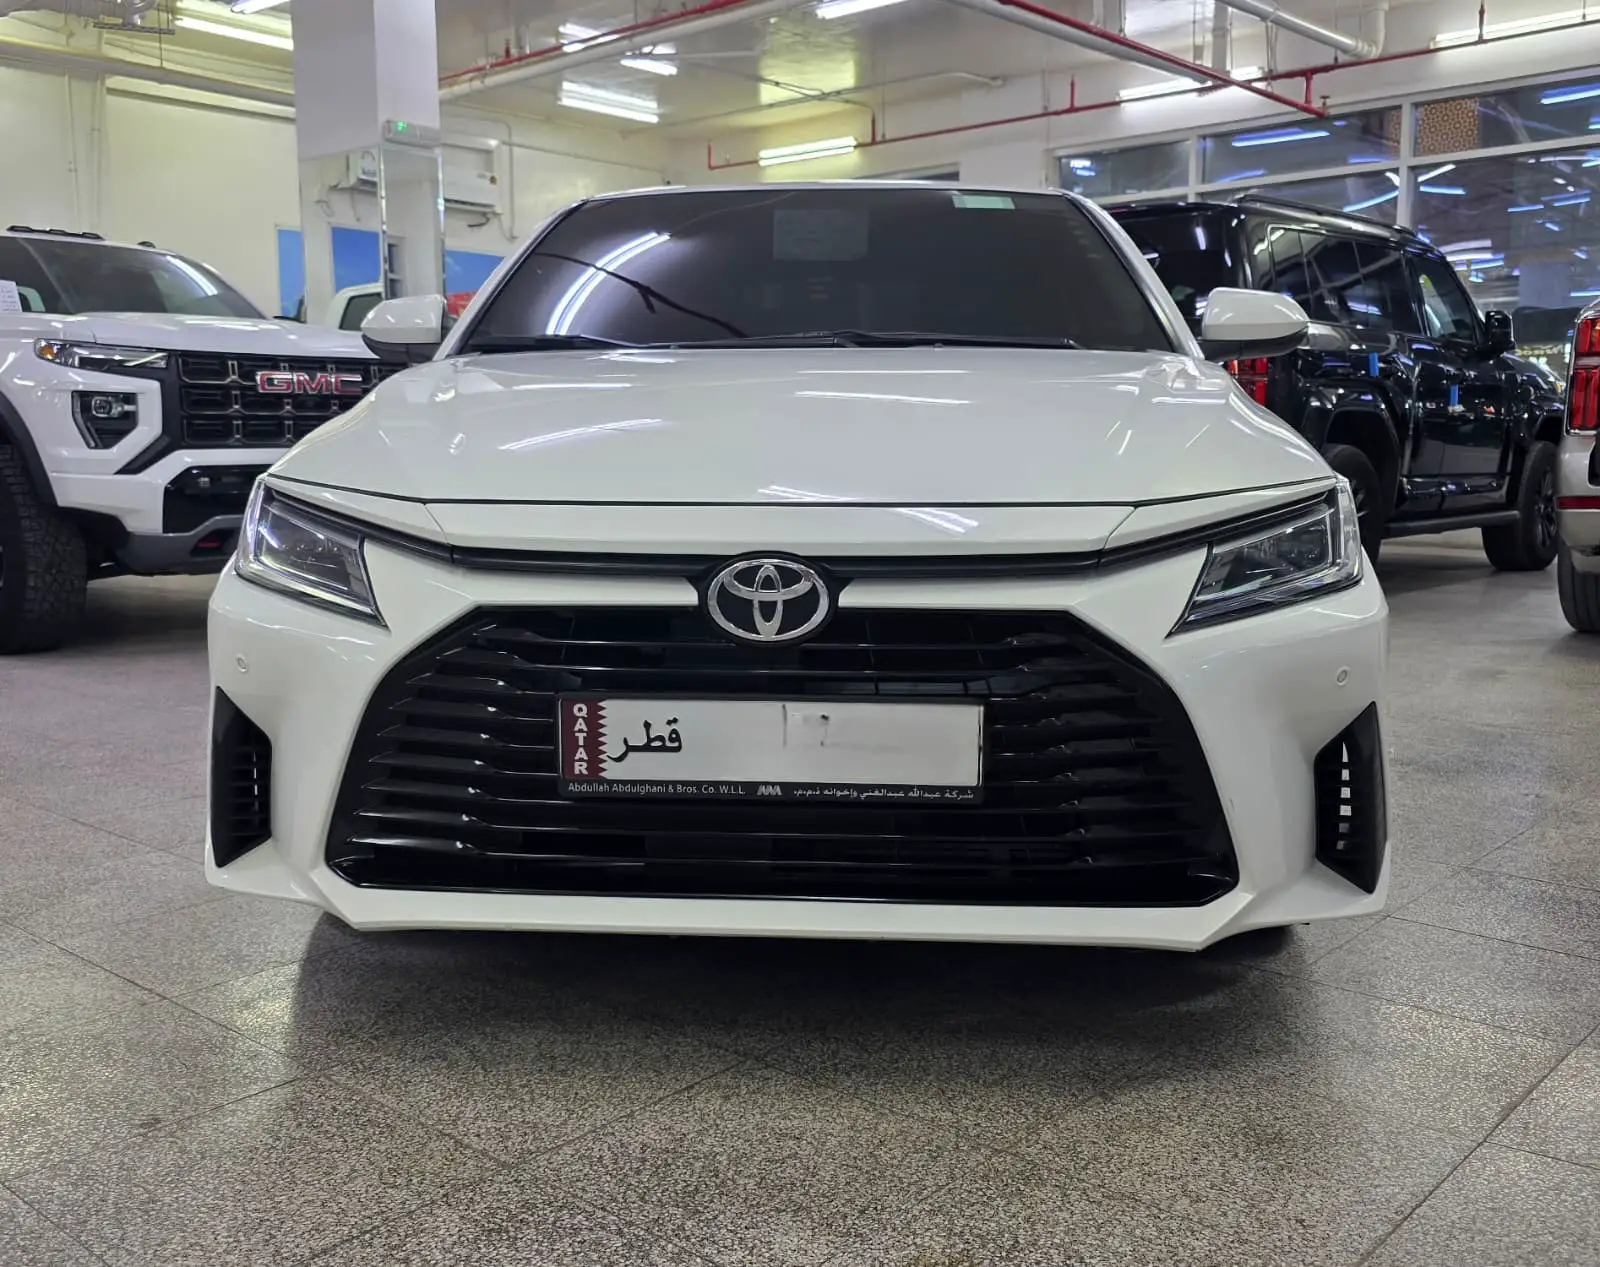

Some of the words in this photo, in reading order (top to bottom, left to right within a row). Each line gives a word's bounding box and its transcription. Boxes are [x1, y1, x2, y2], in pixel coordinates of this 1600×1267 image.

[255, 371, 362, 395] GMC
[572, 703, 588, 775] QATAR
[606, 716, 682, 763] قطر
[568, 782, 610, 792] Abdullah
[611, 783, 666, 795] Abdulghani
[668, 784, 674, 793] &
[719, 784, 746, 794] W.L.L.
[944, 789, 974, 800] شركة
